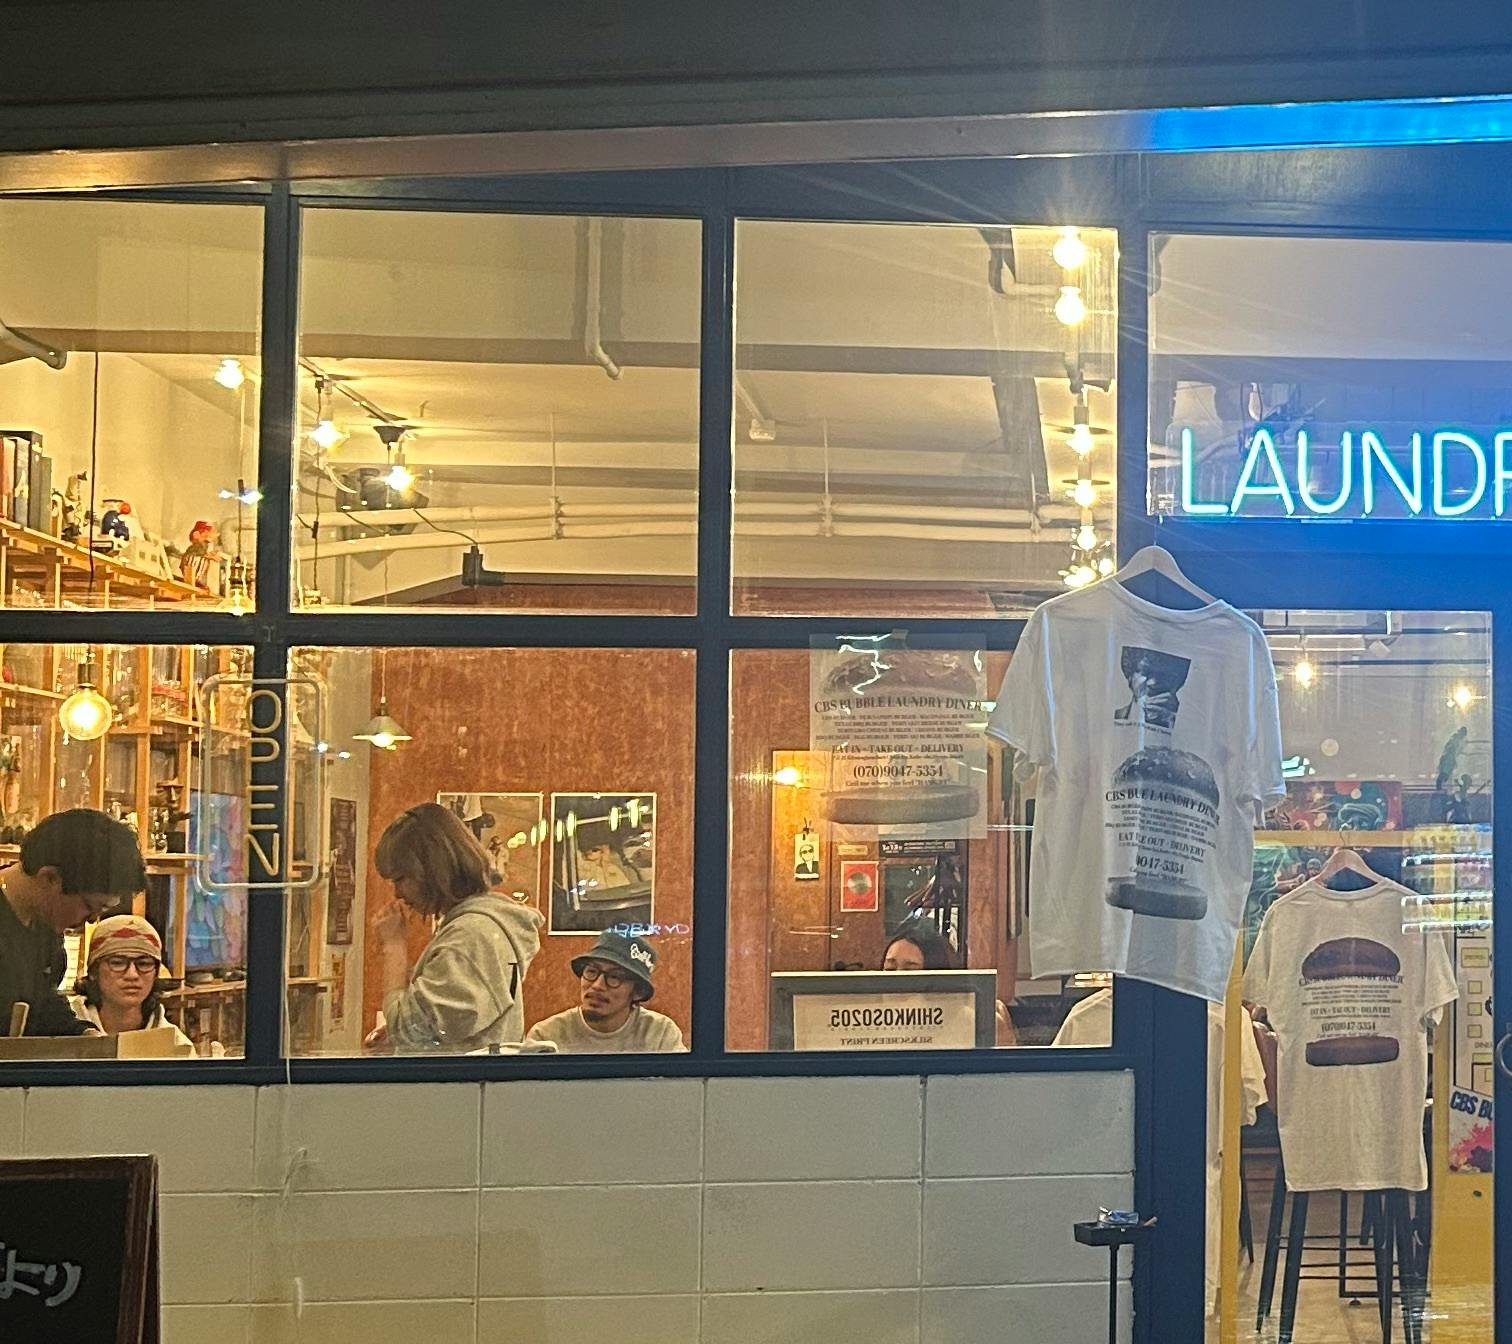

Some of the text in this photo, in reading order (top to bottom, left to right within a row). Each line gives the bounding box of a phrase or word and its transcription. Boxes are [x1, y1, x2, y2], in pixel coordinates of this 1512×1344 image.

[815, 701, 837, 713] CBS
[888, 696, 943, 709] LAUNDRY
[852, 745, 861, 754] IN
[870, 744, 892, 754] TAKE
[893, 744, 913, 753] OUT
[921, 744, 964, 753] DELIVERY
[853, 765, 943, 778] (070)9047-5354
[246, 689, 282, 876] OPEN
[1106, 790, 1125, 802] CBS
[1150, 791, 1197, 809] LAUNDRY
[1147, 836, 1164, 847] OUT
[1170, 842, 1206, 856] DELIVERY
[1450, 1091, 1478, 1115] CBS
